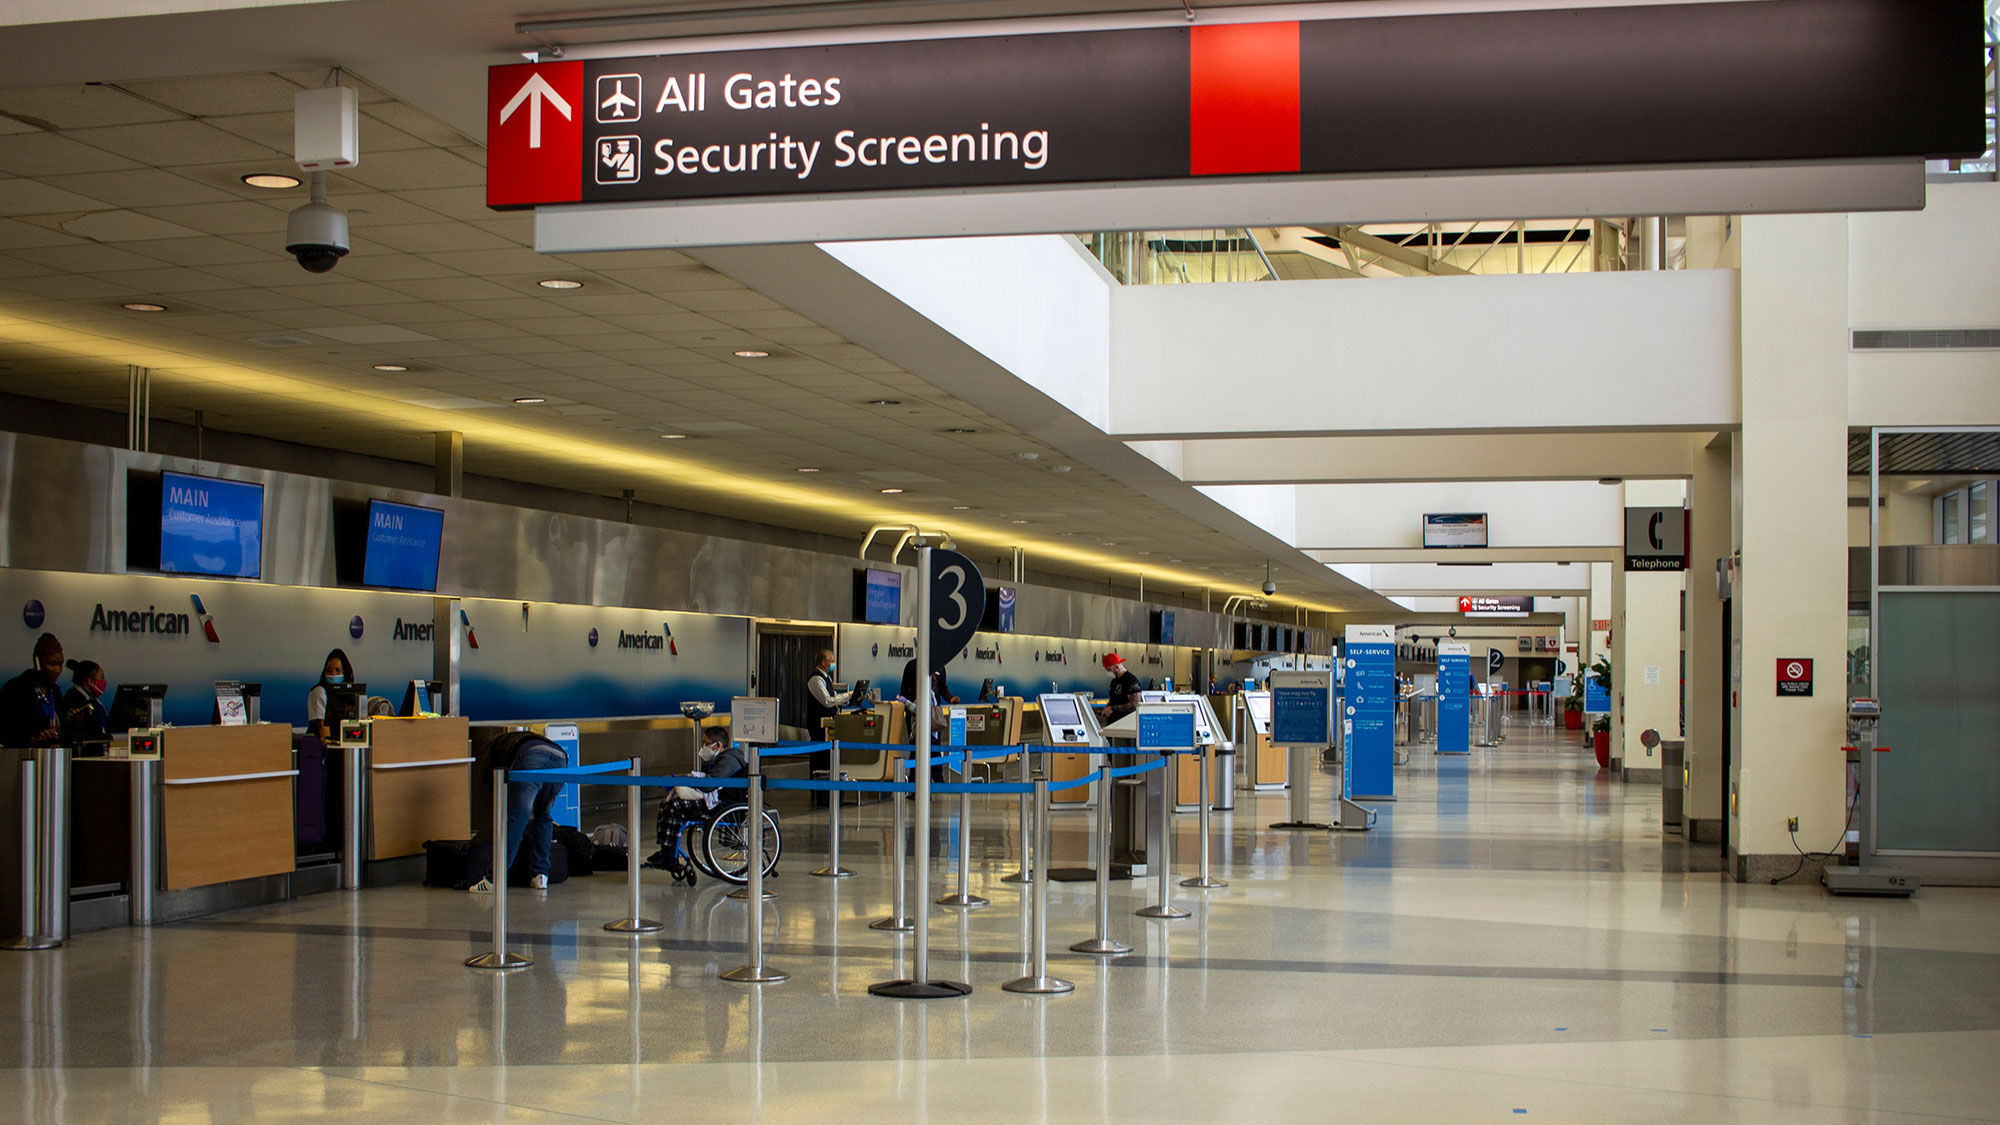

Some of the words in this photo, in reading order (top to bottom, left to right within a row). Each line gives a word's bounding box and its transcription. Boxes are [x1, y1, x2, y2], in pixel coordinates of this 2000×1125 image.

[656, 73, 706, 112] All
[724, 74, 842, 111] Gates
[653, 133, 822, 180] Security
[834, 122, 1050, 172] Screening
[169, 486, 208, 507] MAIN
[169, 511, 204, 523] Customer
[374, 512, 403, 530] MAIN
[1631, 559, 1680, 569] Telephone
[938, 565, 967, 630] 3
[1497, 604, 1520, 612] Screening
[90, 603, 189, 634] American
[1594, 620, 1607, 631] EXIT
[393, 618, 434, 641] Ameri
[618, 629, 663, 649] American
[888, 643, 914, 658] American
[975, 647, 996, 660] American
[1490, 652, 1501, 668] 2
